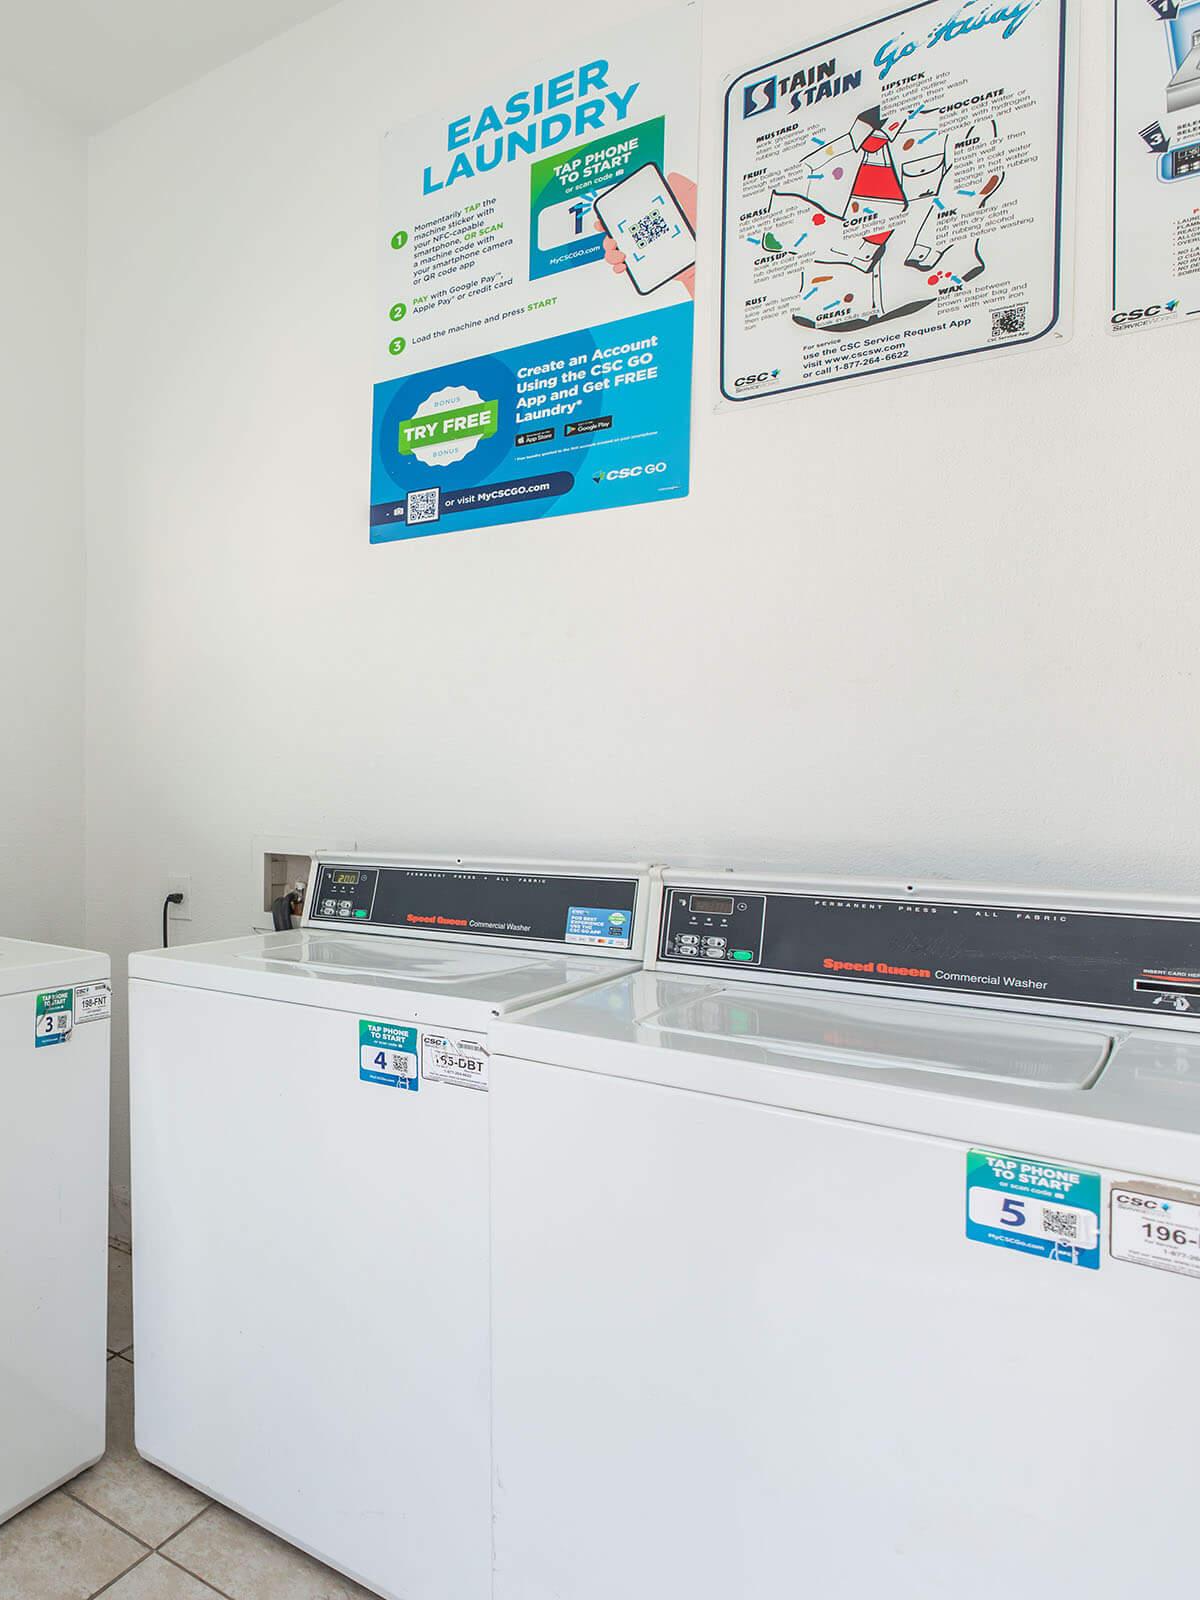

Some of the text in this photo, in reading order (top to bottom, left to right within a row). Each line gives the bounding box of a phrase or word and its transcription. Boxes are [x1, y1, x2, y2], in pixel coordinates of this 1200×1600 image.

[874, 0, 1041, 80] Go Away
[788, 70, 862, 114] STAIN
[881, 71, 926, 92] LIPSTICK
[448, 59, 609, 152] EASIER
[939, 89, 1004, 114] CHOCOLATE
[991, 95, 1030, 111] hydrogen
[423, 82, 640, 195] LAUNDRY
[756, 123, 799, 143] MUSTARD
[954, 137, 980, 150] MUD
[1150, 134, 1162, 145] 3
[553, 138, 639, 177] TAP PHONE
[1007, 156, 1038, 169] rubbing
[560, 152, 632, 186] TO START
[744, 168, 768, 180] FRUIT
[576, 180, 592, 190] scan
[954, 178, 983, 190] alcohol
[414, 198, 496, 232] Momentarily TAP the
[569, 202, 583, 235] 1
[740, 208, 768, 221] GRASS
[843, 213, 878, 227] COFFEE
[937, 209, 957, 219] INK
[960, 205, 998, 218] hairspray
[988, 209, 1008, 219] cloth
[414, 208, 494, 241] machine sticker with
[464, 233, 476, 241] OR
[479, 223, 503, 236] SCAN
[951, 214, 1015, 235] rubbing alcohol
[1000, 217, 1034, 230] washing
[414, 221, 484, 251] your NFC-capable
[413, 239, 513, 277] your smartphone camera
[420, 235, 494, 264] machine code with
[754, 251, 788, 265] CATSUP
[424, 261, 475, 282] QR code app
[412, 282, 478, 305] PAY with Google
[413, 278, 513, 314] Apple credit card
[938, 285, 963, 295] WAX
[975, 280, 1010, 292] between
[745, 296, 767, 306] RUST
[412, 334, 431, 344] Load
[448, 319, 482, 334] machine
[484, 314, 500, 323] and
[502, 308, 525, 320] press
[527, 297, 557, 312] START
[816, 308, 851, 321] GREASE
[1111, 306, 1161, 323] CSC
[803, 318, 971, 360] use the CSC Service Request App
[517, 336, 658, 378] Create an Account
[803, 342, 906, 369] visit www.cscsw.com
[835, 351, 909, 372] 1-877-264-6622
[517, 352, 653, 394] Using the CSC GO
[735, 373, 768, 386] CSC
[517, 367, 658, 409] App and Get FREE
[434, 397, 461, 407] BONUS
[403, 410, 491, 441] TRY FREE
[597, 421, 609, 429] Play
[433, 448, 459, 458] BONUS
[606, 462, 666, 480] CSC GO
[457, 497, 475, 505] visit
[477, 482, 550, 502] MyCSCGO.com
[814, 900, 883, 910] PERMANENT
[899, 905, 937, 914] PRESS
[1018, 913, 1069, 923] FABRIC
[407, 914, 531, 932] Speed Queen Commercial Washer
[823, 958, 1048, 990] Speed Queen Commercial Washer
[46, 1016, 53, 1032] 3
[368, 1025, 409, 1037] TAP PHONE
[382, 1033, 406, 1043] START
[374, 1052, 387, 1069] 4
[986, 1156, 1080, 1184] TAP PHONE
[992, 1167, 1073, 1192] TO START
[999, 1198, 1026, 1227] 5
[1117, 1195, 1158, 1209] CSC
[1142, 1224, 1200, 1248] 196-
